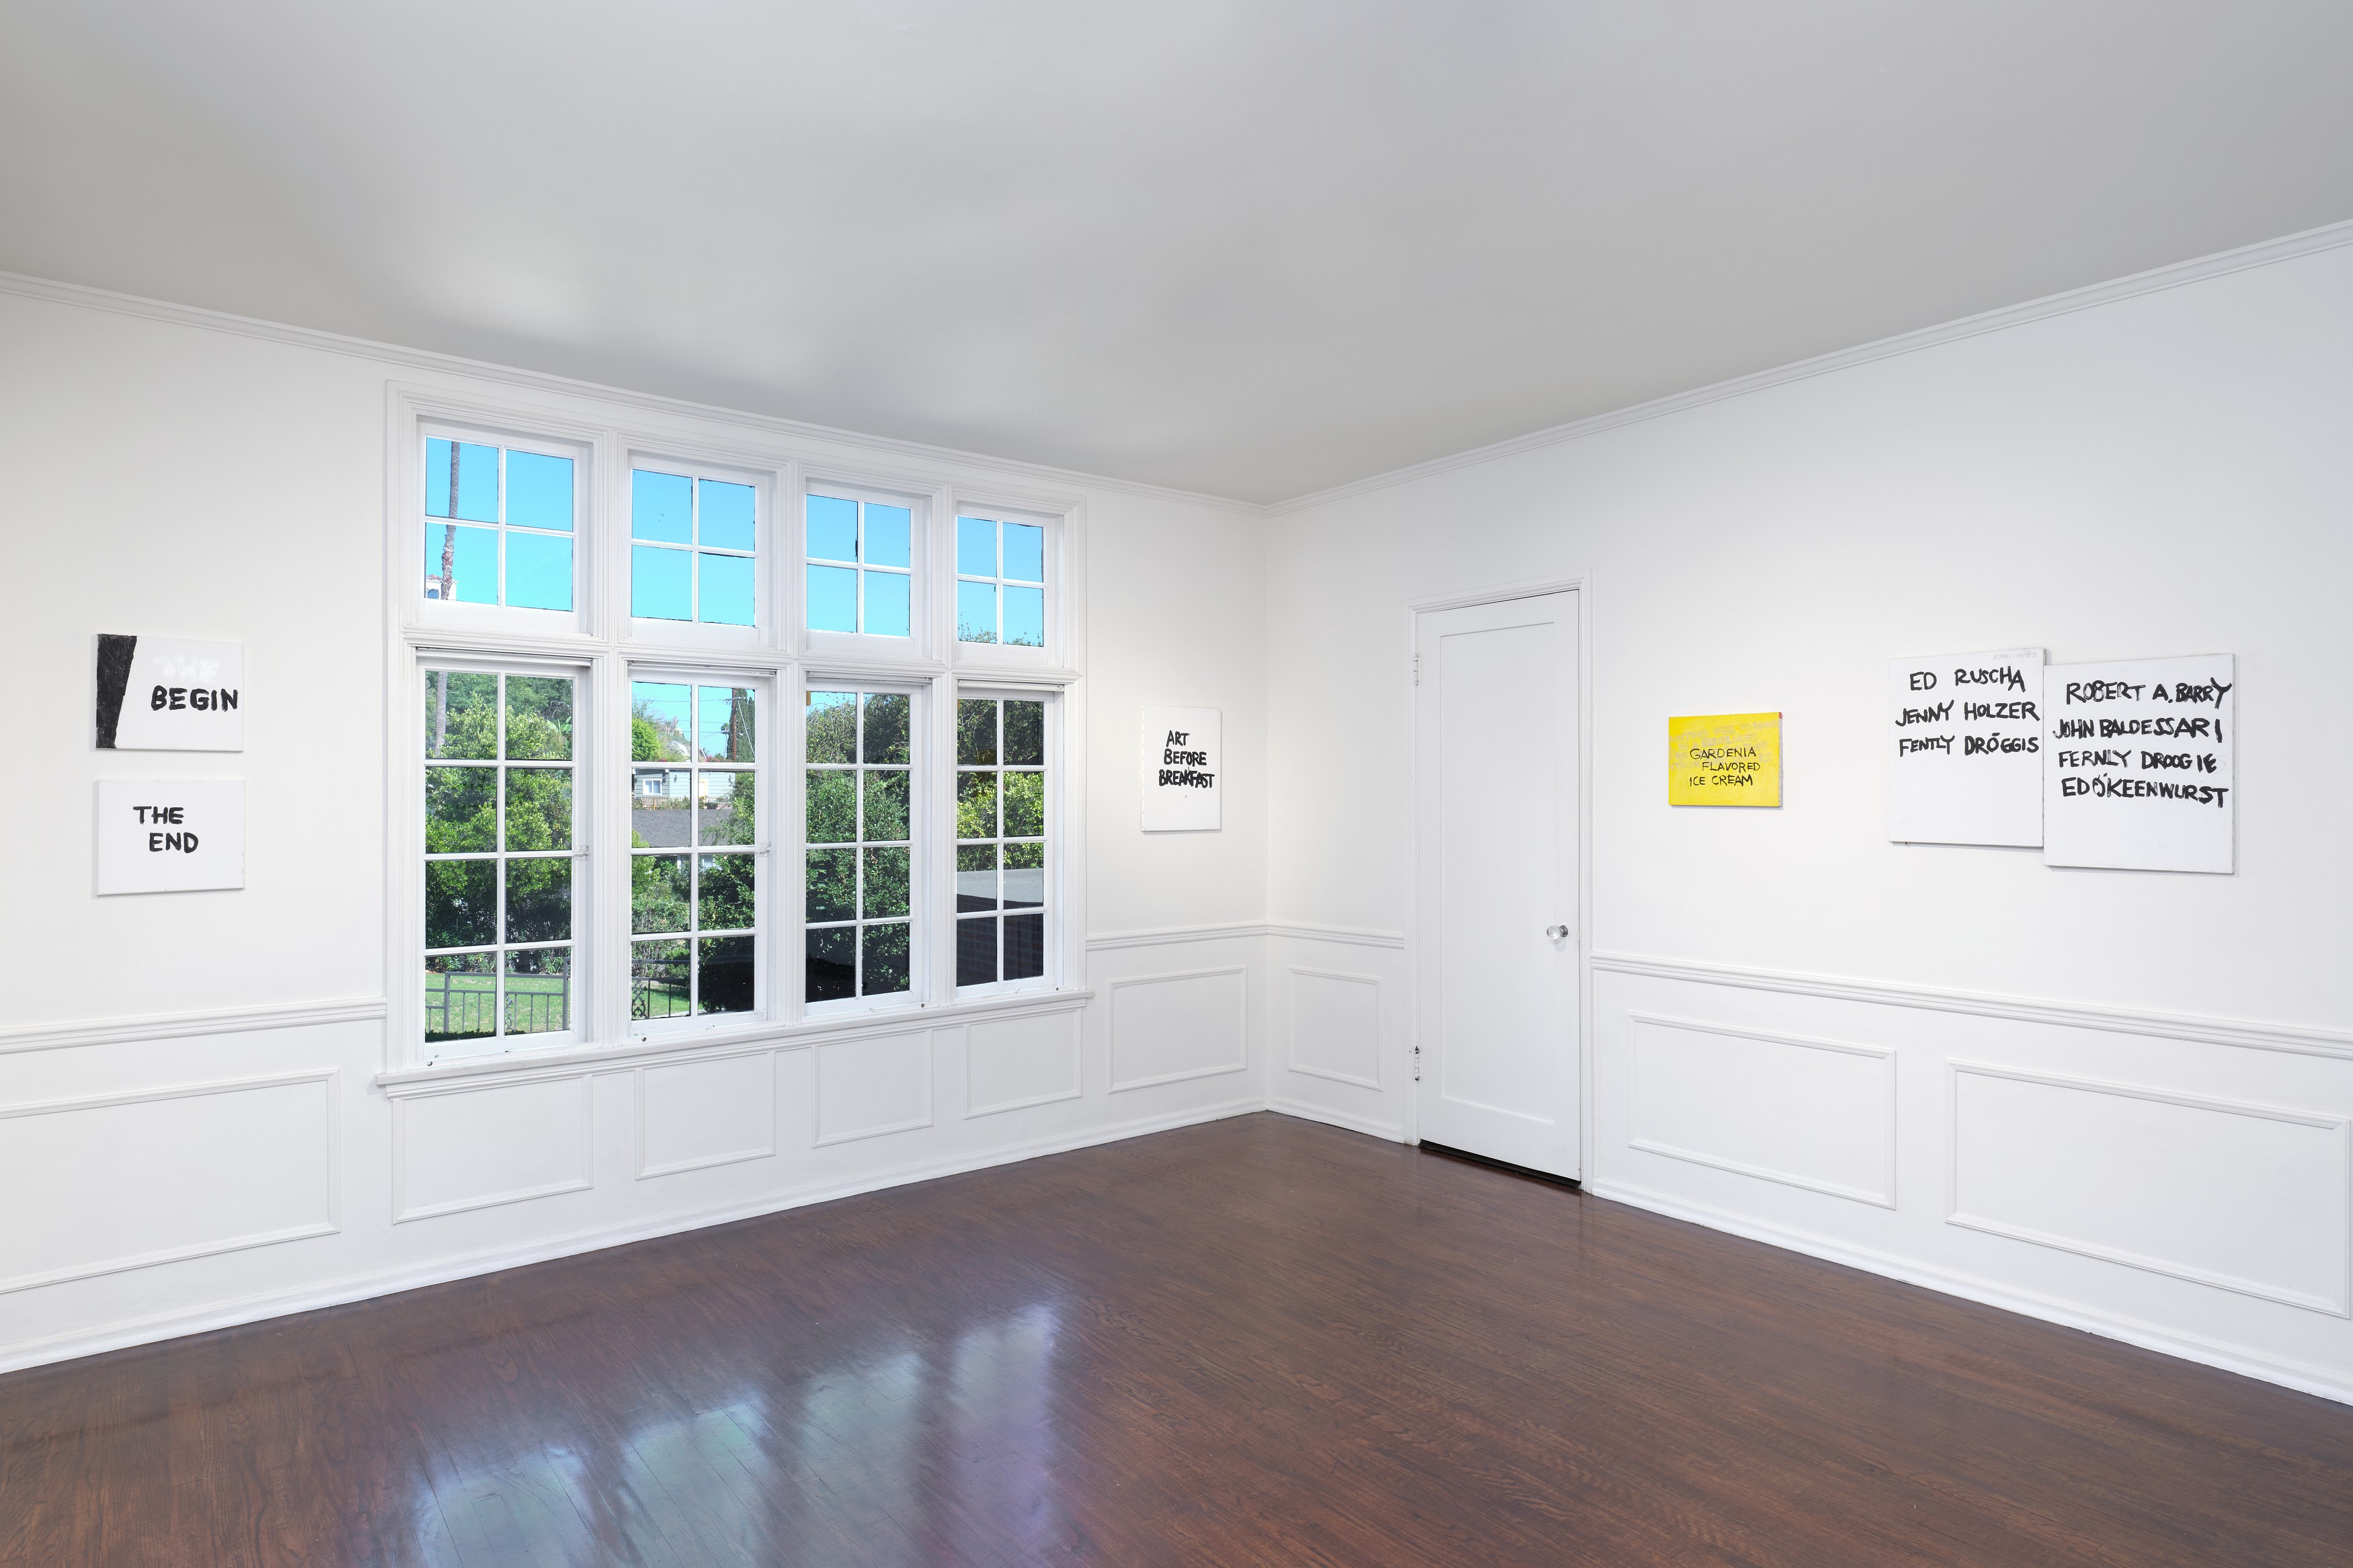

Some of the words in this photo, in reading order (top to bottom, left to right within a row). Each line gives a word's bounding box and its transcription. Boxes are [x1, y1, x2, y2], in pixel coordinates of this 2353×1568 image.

[1910, 672, 1936, 690] ED
[1954, 666, 2026, 692] RUSCHA
[151, 686, 238, 712] BEGIN
[2067, 680, 2146, 704] ROBERT
[2176, 677, 2232, 709] BARRY
[1895, 700, 1954, 727] JENNY
[1964, 702, 2040, 721] HOLZER
[2053, 719, 2094, 739] JOHN
[1166, 731, 1189, 747] ART
[1164, 749, 1207, 767] BEFORE
[1690, 747, 1756, 759] GARDENIA
[2059, 749, 2131, 768] FERNLY
[1702, 761, 1760, 773] FLAVORED
[1159, 770, 1215, 788] BREAKFAST
[1689, 776, 1706, 786] ICE
[1712, 774, 1753, 786] CREAM
[133, 807, 184, 824] THE
[149, 832, 198, 853] END
